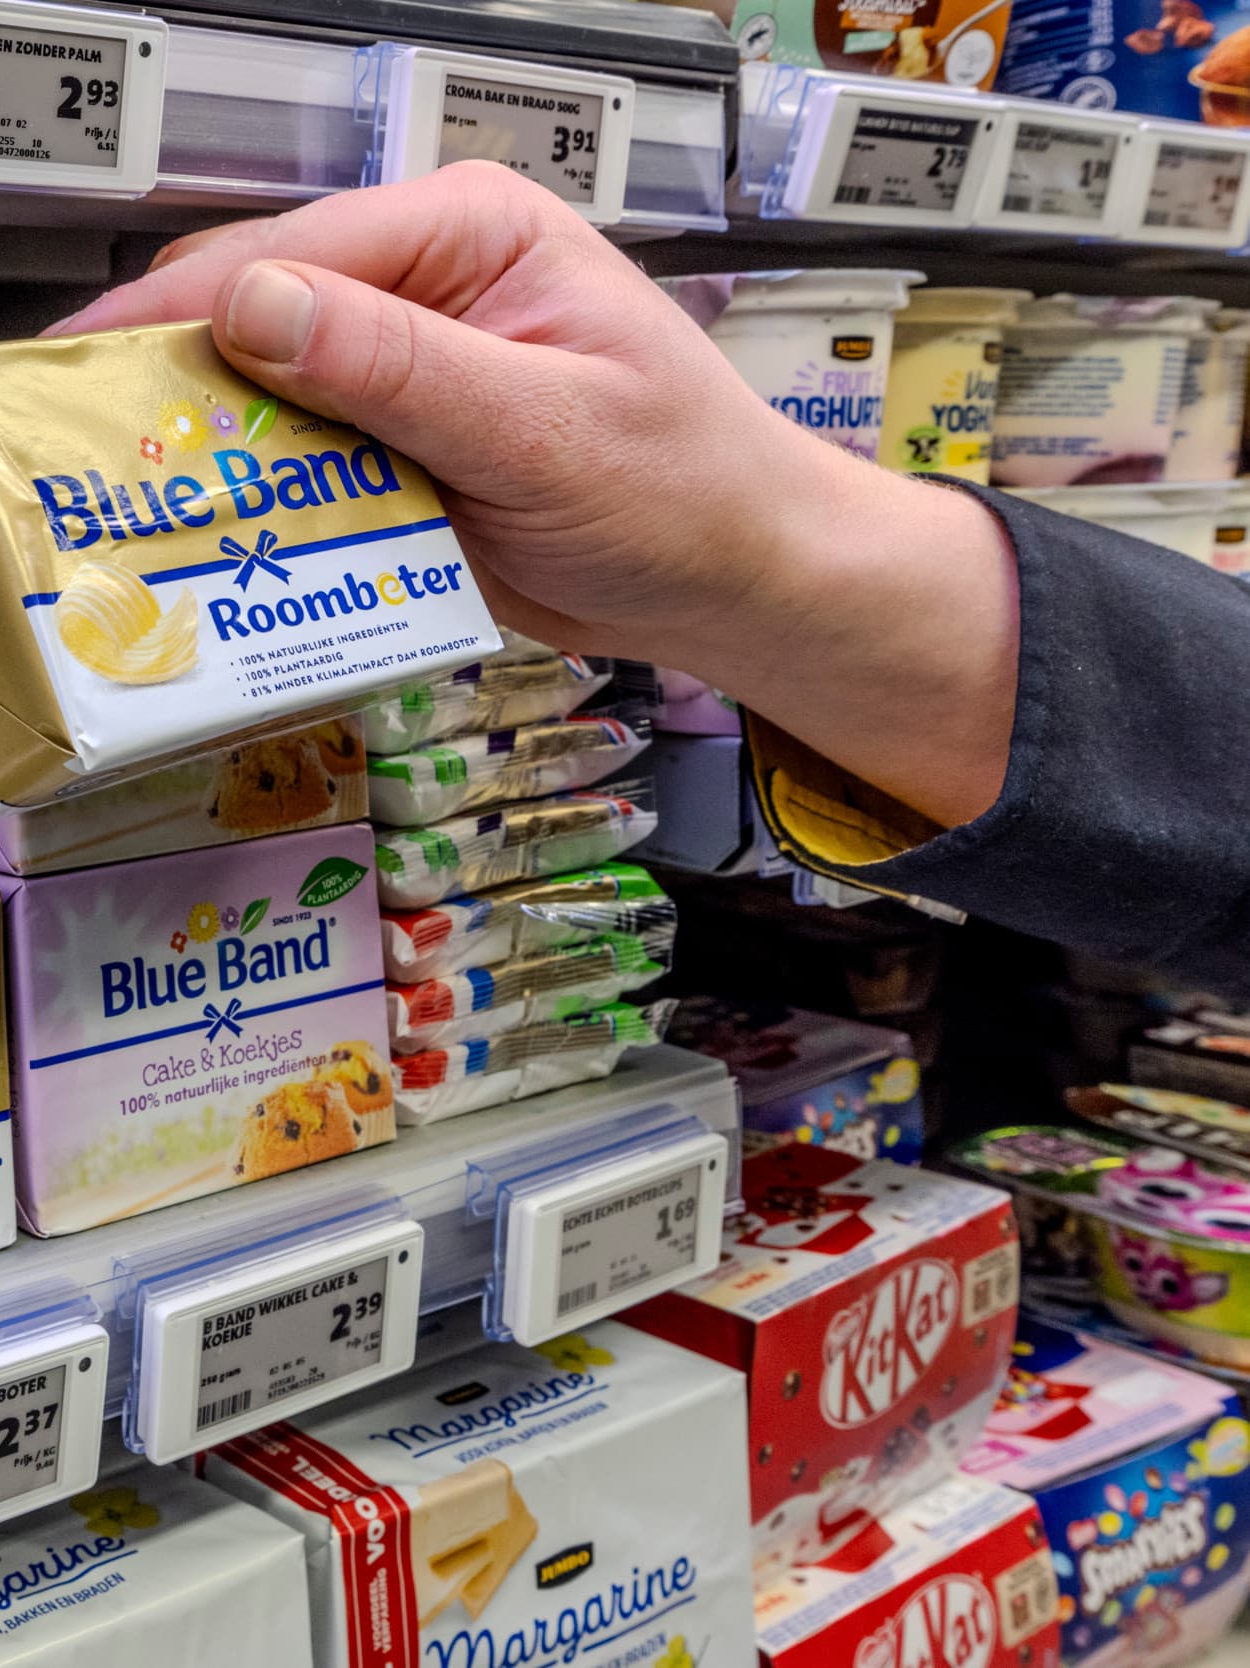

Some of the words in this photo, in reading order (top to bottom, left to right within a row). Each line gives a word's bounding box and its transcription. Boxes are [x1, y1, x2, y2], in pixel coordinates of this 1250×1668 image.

[15, 41, 66, 60] ZONDER
[68, 47, 102, 63] PALM
[444, 84, 483, 101] CROMA
[484, 90, 505, 105] BAK
[507, 94, 520, 106] EN
[521, 96, 555, 111] BRAAD
[822, 370, 872, 395] FRUIT
[290, 421, 323, 436] SINDS
[770, 396, 882, 429] OGHURT
[32, 468, 216, 553] Blue
[212, 433, 402, 520] Band
[237, 651, 266, 667] 100%
[267, 636, 336, 660] NATUURLIJKE
[336, 619, 410, 645] INGREDIËNTEN
[244, 667, 271, 682] 100%
[272, 651, 344, 678] PLANTAARDIG
[251, 684, 272, 698] 81%
[274, 673, 314, 694] MINDER
[316, 657, 394, 687] KLIMAATIMPACT
[395, 649, 419, 665] DAN
[306, 869, 362, 904] PLANTAARDIG
[321, 873, 343, 890] 100%
[100, 955, 206, 1018] Blue
[217, 918, 330, 991] Band
[142, 1054, 197, 1087] Cake
[200, 1048, 215, 1072] &
[218, 1029, 303, 1069] Koekjes
[119, 1091, 161, 1116] 100%
[165, 1073, 240, 1105] natuurlijke
[243, 1053, 327, 1088] ingrediënten
[562, 1209, 594, 1233] ECHTE
[203, 1320, 213, 1335] B
[215, 1307, 255, 1332] BAND
[258, 1290, 309, 1316] WIKKEL
[311, 1275, 345, 1299] CAKE
[347, 1271, 358, 1286] &
[202, 1322, 253, 1351] KOEKJE
[369, 1371, 594, 1451] Margarine
[540, 1550, 591, 1583] JUMBO
[5, 1600, 59, 1631] BAKKEN
[56, 1594, 76, 1610] EN
[73, 1571, 127, 1605] BRADEN
[424, 1555, 697, 1668] Margarine
